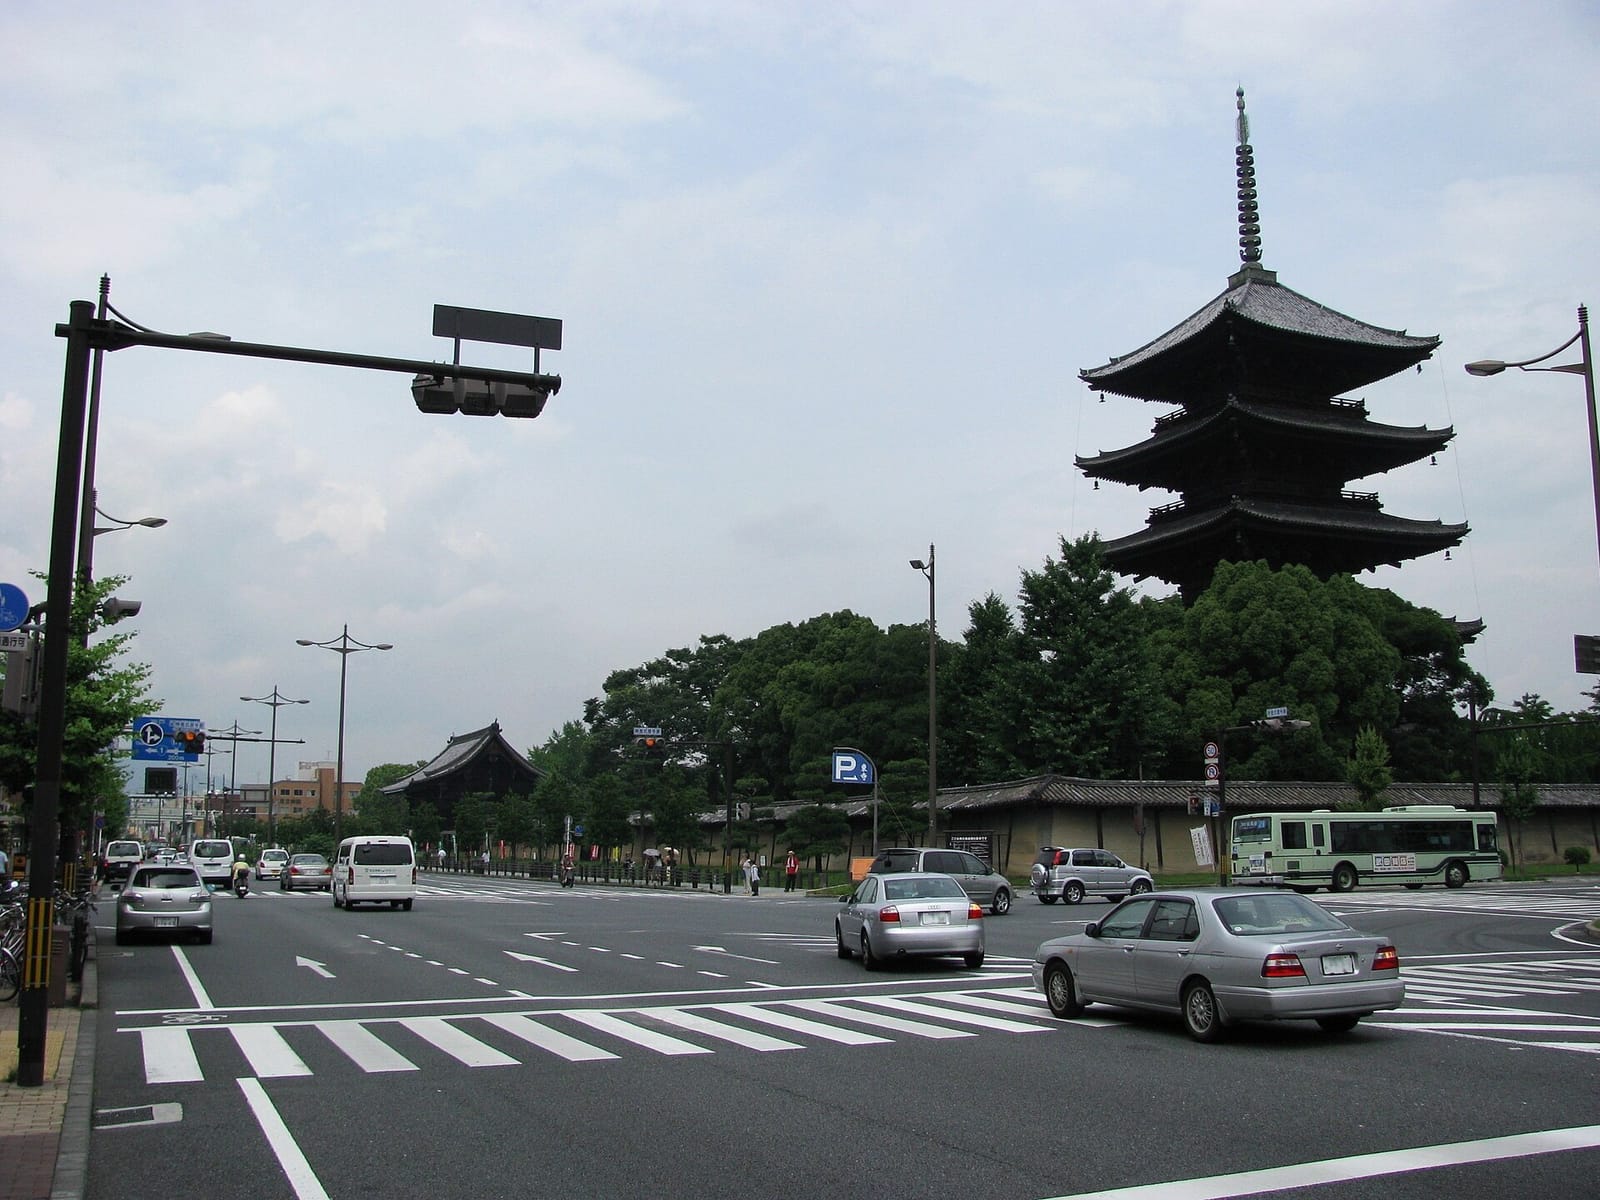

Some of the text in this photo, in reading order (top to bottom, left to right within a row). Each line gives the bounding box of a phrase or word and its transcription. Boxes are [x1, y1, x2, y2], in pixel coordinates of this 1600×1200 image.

[0, 636, 25, 647] 通行可
[836, 756, 856, 780] P
